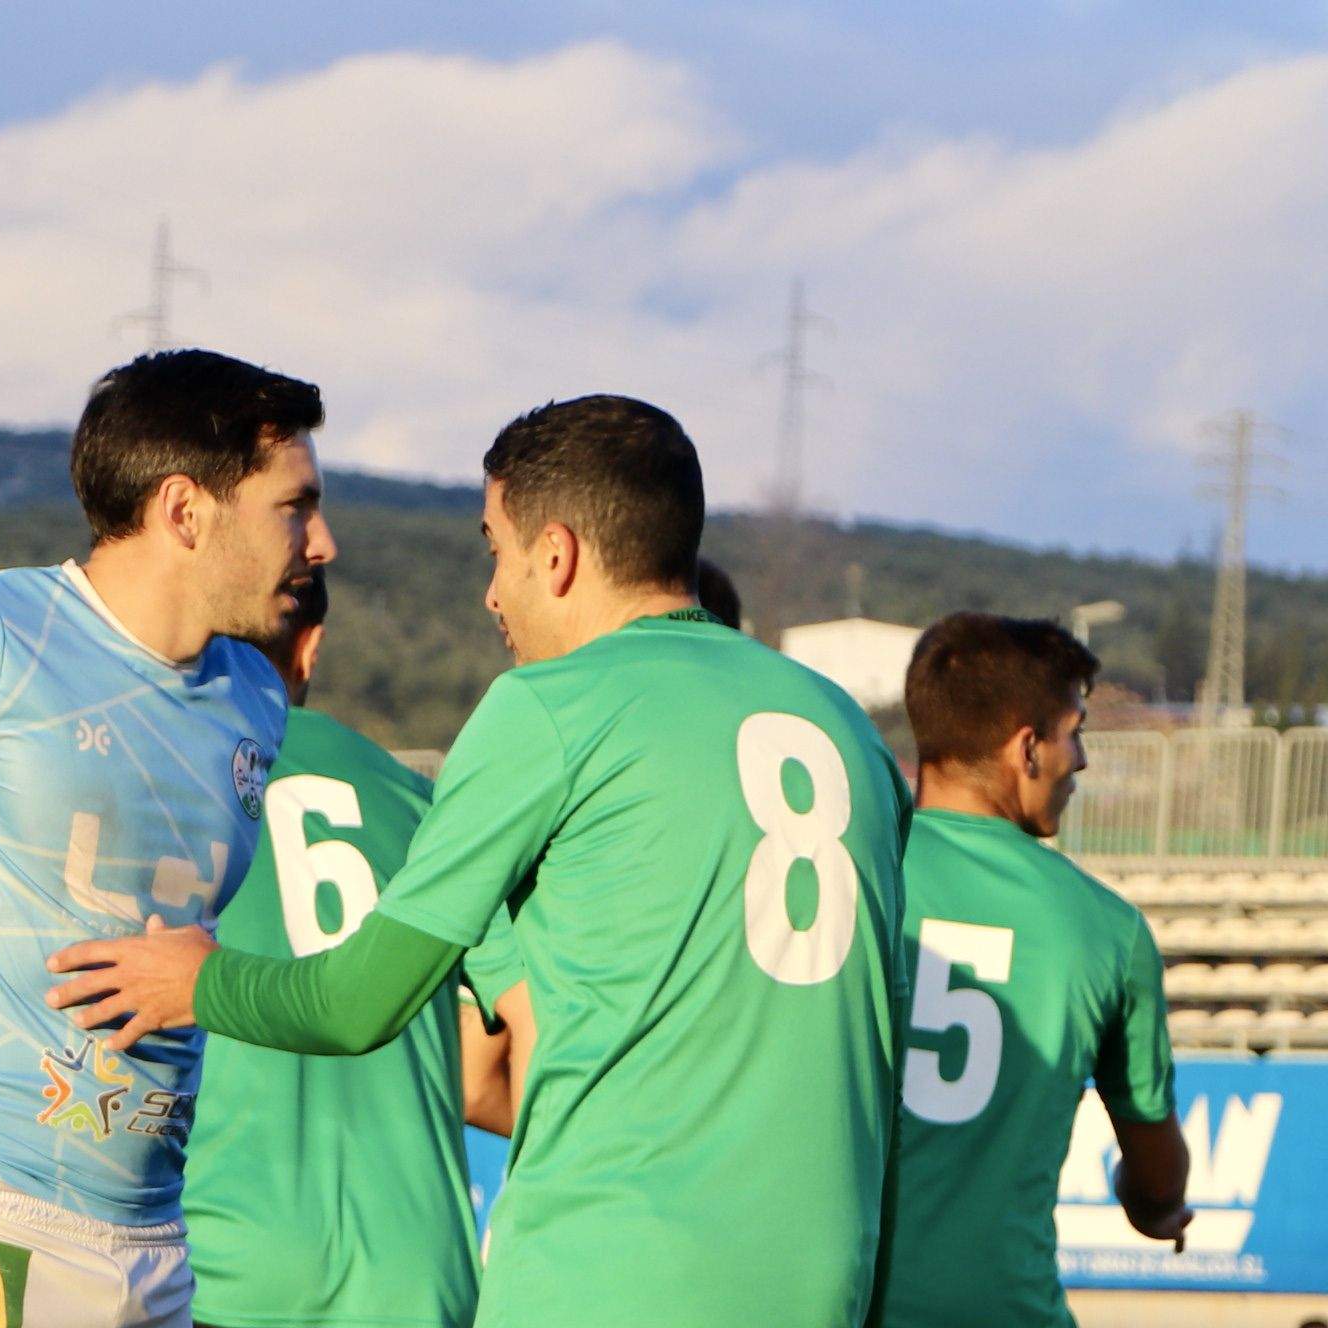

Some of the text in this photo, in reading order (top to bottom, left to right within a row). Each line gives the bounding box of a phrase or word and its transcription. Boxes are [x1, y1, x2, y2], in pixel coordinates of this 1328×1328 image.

[265, 773, 380, 958] 6
[736, 711, 858, 985] 8
[902, 917, 1014, 1124] 5
